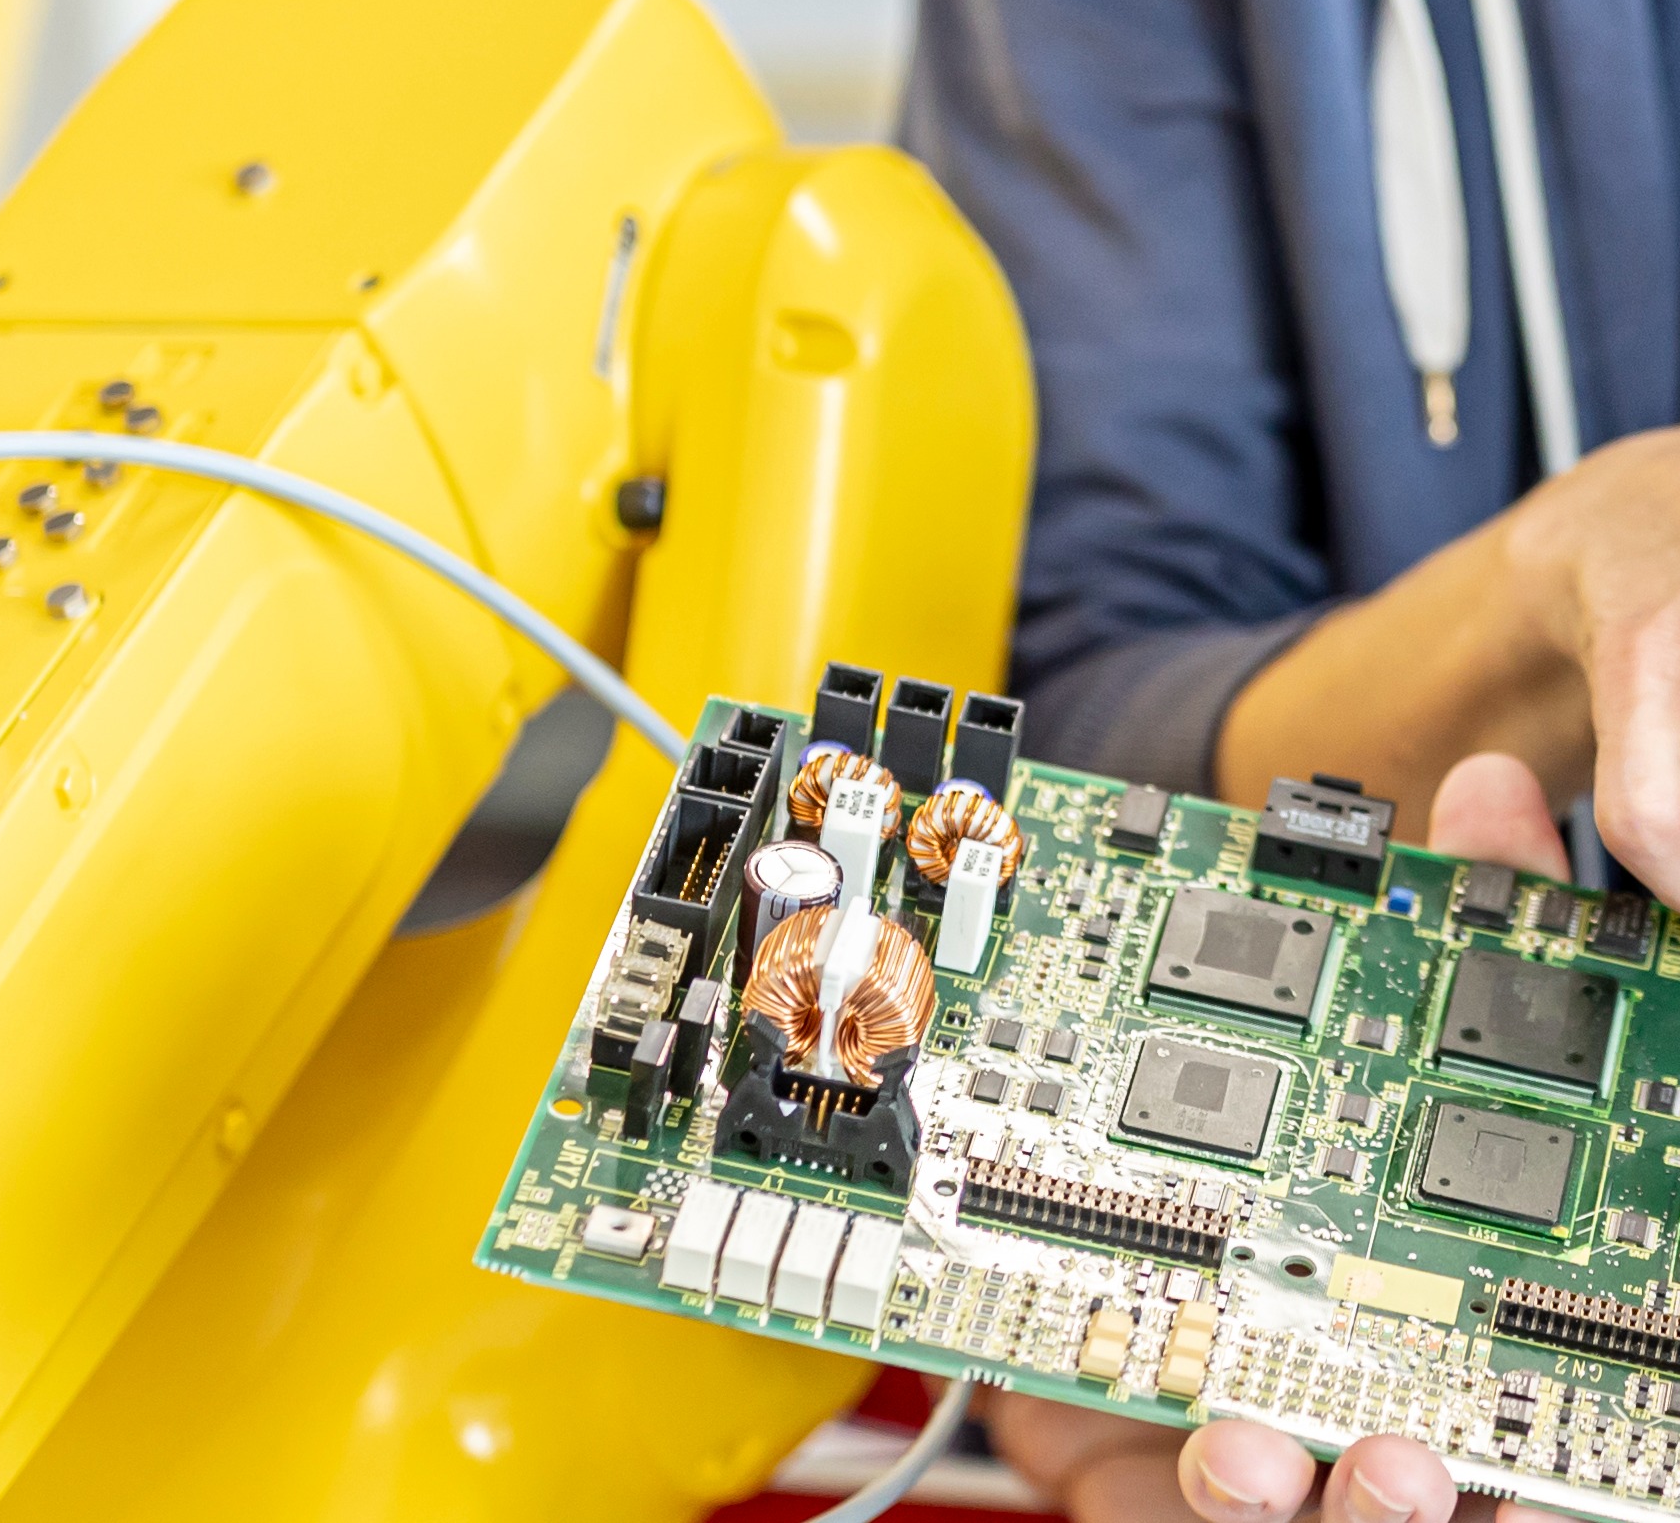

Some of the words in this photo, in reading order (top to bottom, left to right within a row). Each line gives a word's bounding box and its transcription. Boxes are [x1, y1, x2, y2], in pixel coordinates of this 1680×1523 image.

[550, 1139, 589, 1189] JRY7
[760, 1175, 784, 1193] A1
[823, 1188, 849, 1207] A5
[1554, 1355, 1604, 1383] CN2
